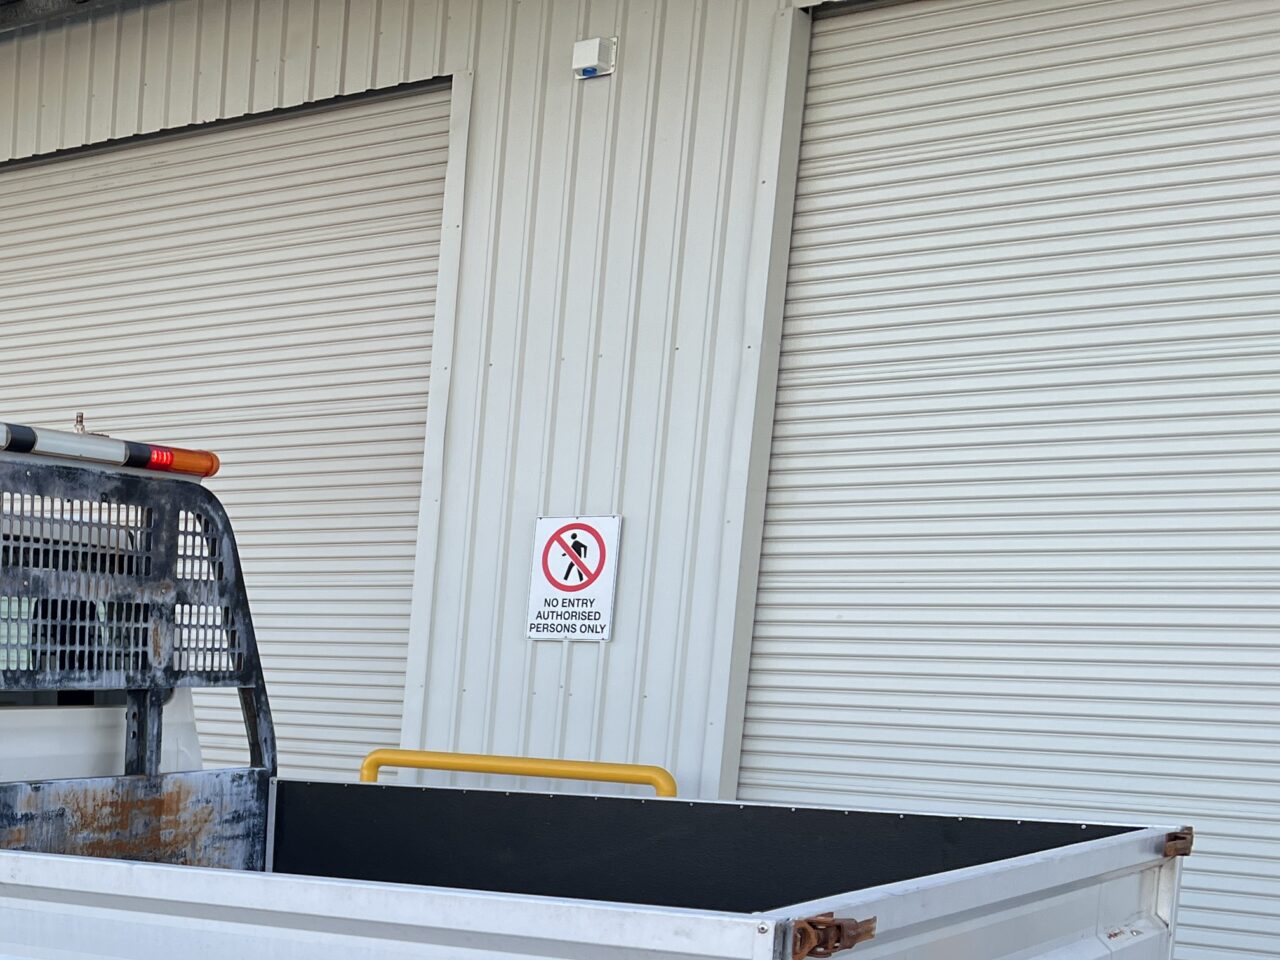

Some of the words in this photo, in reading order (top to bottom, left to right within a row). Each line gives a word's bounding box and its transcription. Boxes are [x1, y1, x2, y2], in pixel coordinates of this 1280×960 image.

[544, 598, 559, 608] NO
[561, 598, 596, 608] ENTRY
[535, 610, 601, 621] AUTHORISED
[529, 622, 577, 633] PERSONS
[579, 623, 607, 634] ONLY
